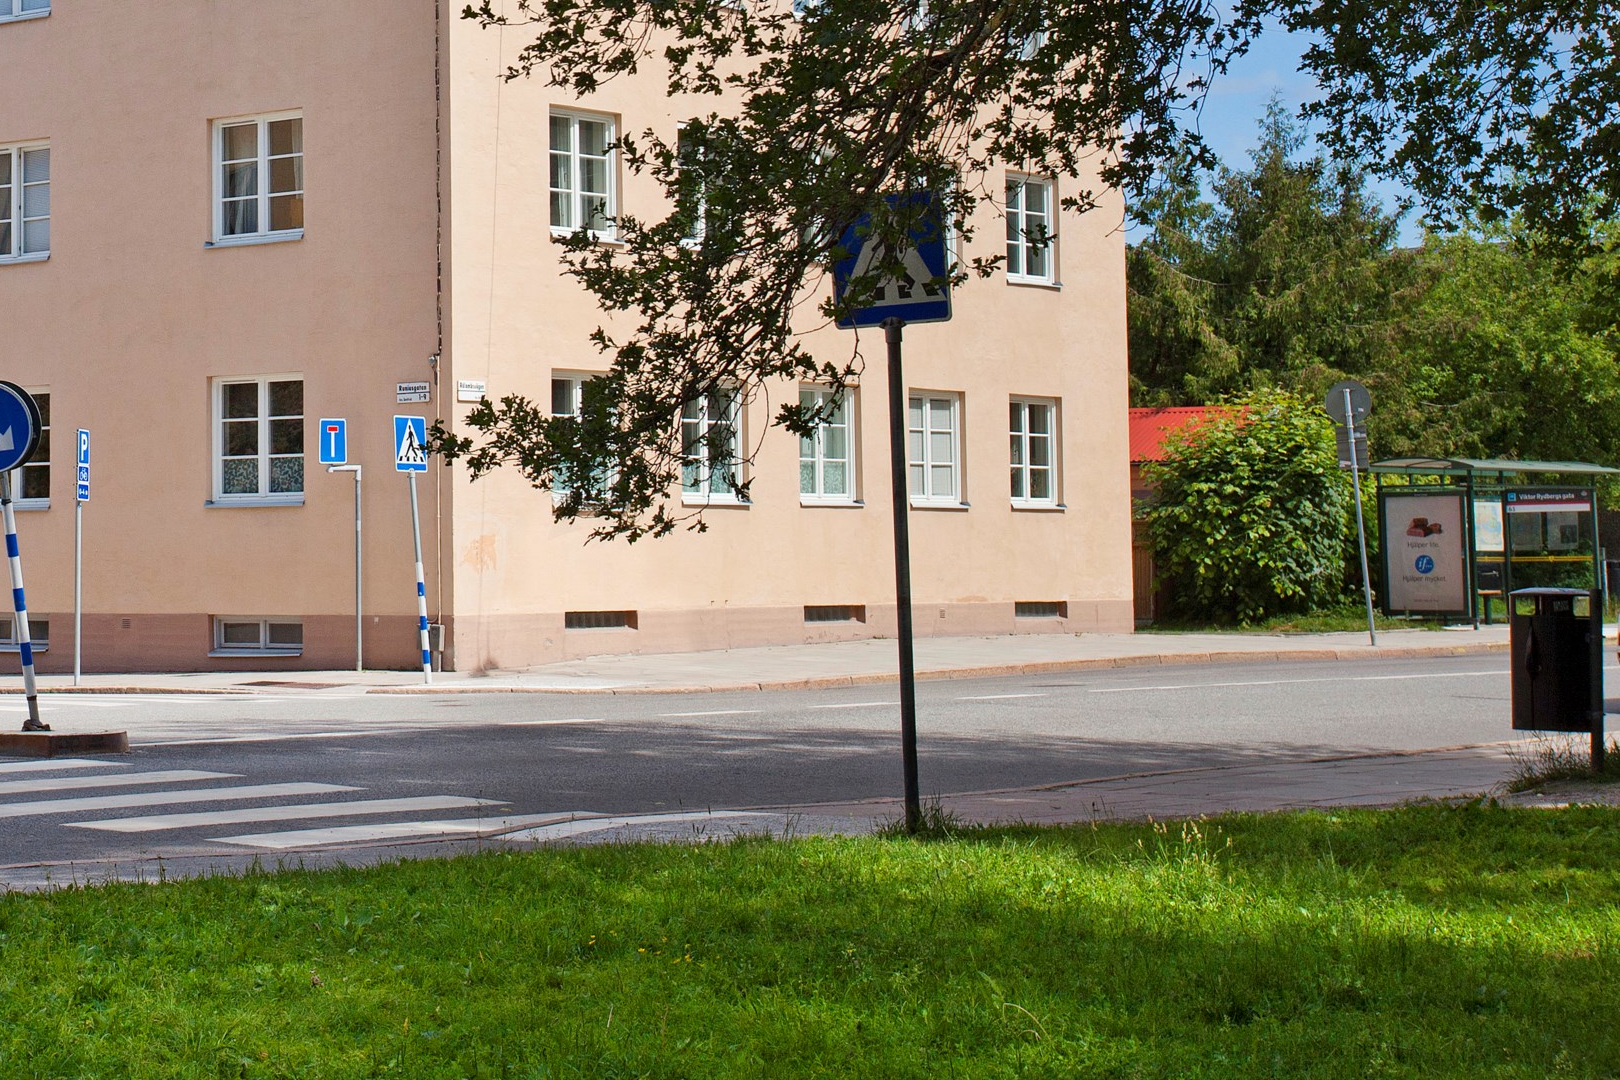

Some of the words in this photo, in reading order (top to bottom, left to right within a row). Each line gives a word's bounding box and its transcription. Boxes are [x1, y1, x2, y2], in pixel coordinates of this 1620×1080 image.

[81, 434, 88, 461] P
[1536, 492, 1562, 501] Rydbergs
[1561, 492, 1575, 500] gata
[1407, 541, 1428, 549] Hjälper
[1402, 575, 1423, 583] Hjälper
